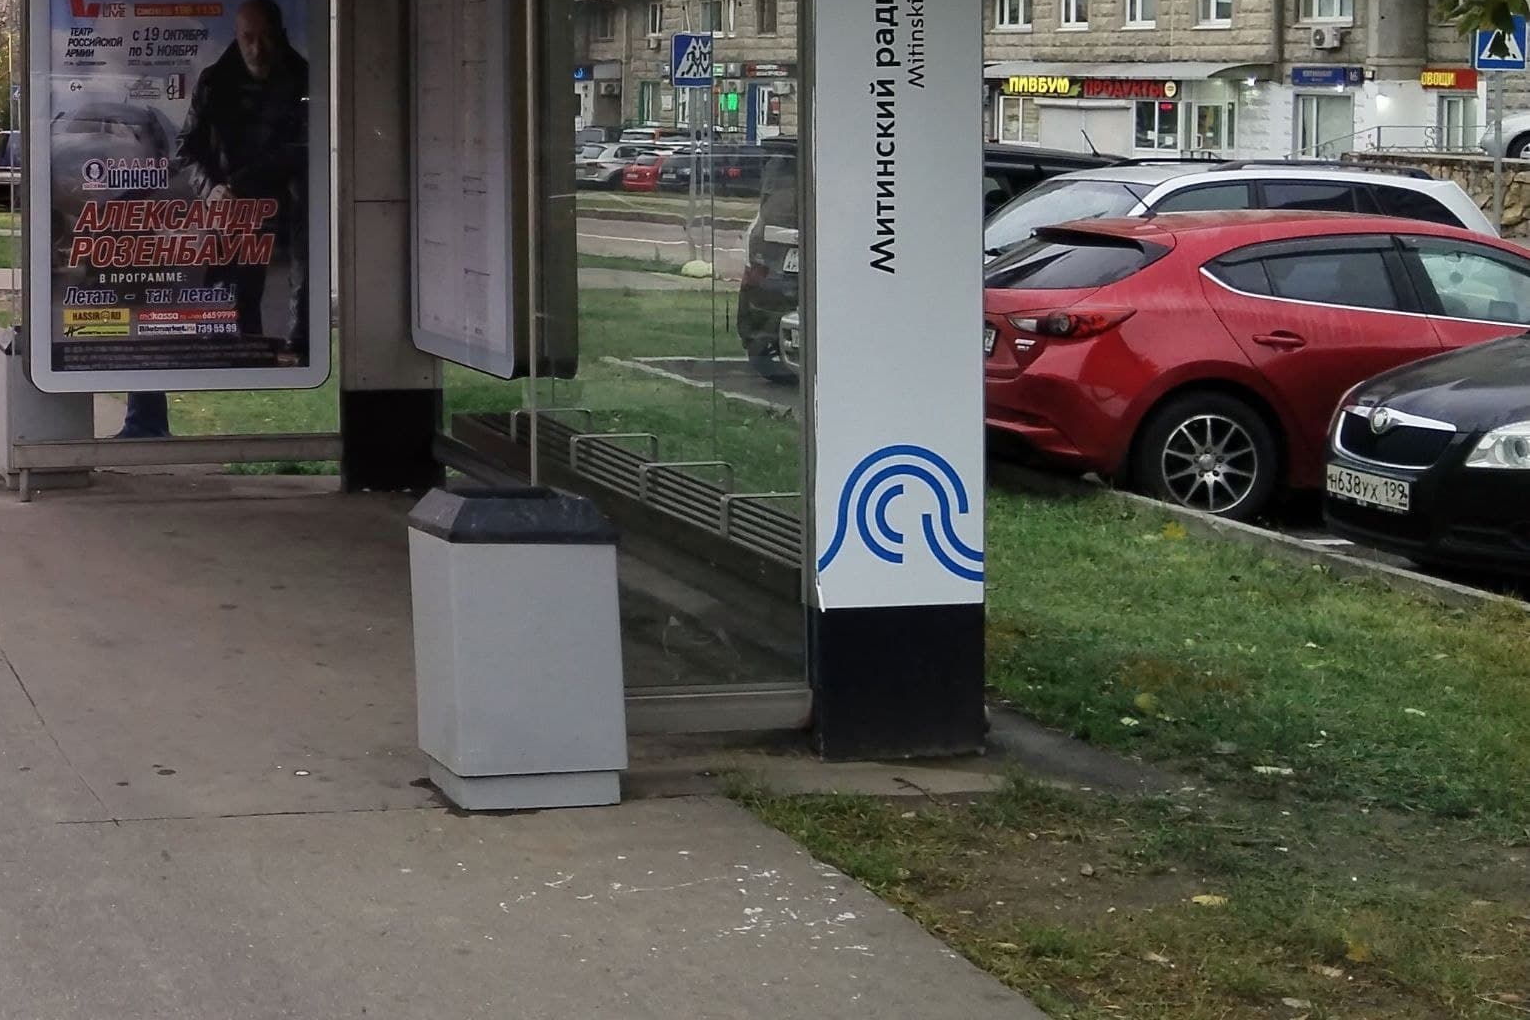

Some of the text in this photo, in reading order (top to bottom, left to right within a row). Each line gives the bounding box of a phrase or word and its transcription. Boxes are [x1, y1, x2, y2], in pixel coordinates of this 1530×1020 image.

[70, 27, 94, 37] ТЕАТР
[144, 27, 160, 41] 19
[162, 29, 210, 41] ОКТЯБРЯ
[67, 37, 124, 47] РОССИЙСКОЙ
[145, 43, 154, 56] 5
[156, 45, 199, 56] НОЯБРЯ
[65, 49, 95, 57] АРМИИ
[70, 82, 83, 92] 6+
[1008, 76, 1070, 93] ПИВБУМ
[1421, 71, 1455, 87] ОВОЩИ
[1083, 80, 1166, 98] ПРОДУКТЫ
[106, 158, 169, 169] РАДИО
[106, 168, 169, 189] ШАНСОН
[870, 79, 896, 274] Митинский
[73, 199, 279, 236] АЛЕКСАНДР
[69, 233, 276, 268] РОЗЕНБАУМ
[99, 274, 106, 283] В
[63, 287, 117, 306] Летать
[145, 289, 173, 304] так
[177, 284, 236, 303] летать!
[1383, 480, 1405, 500] 199
